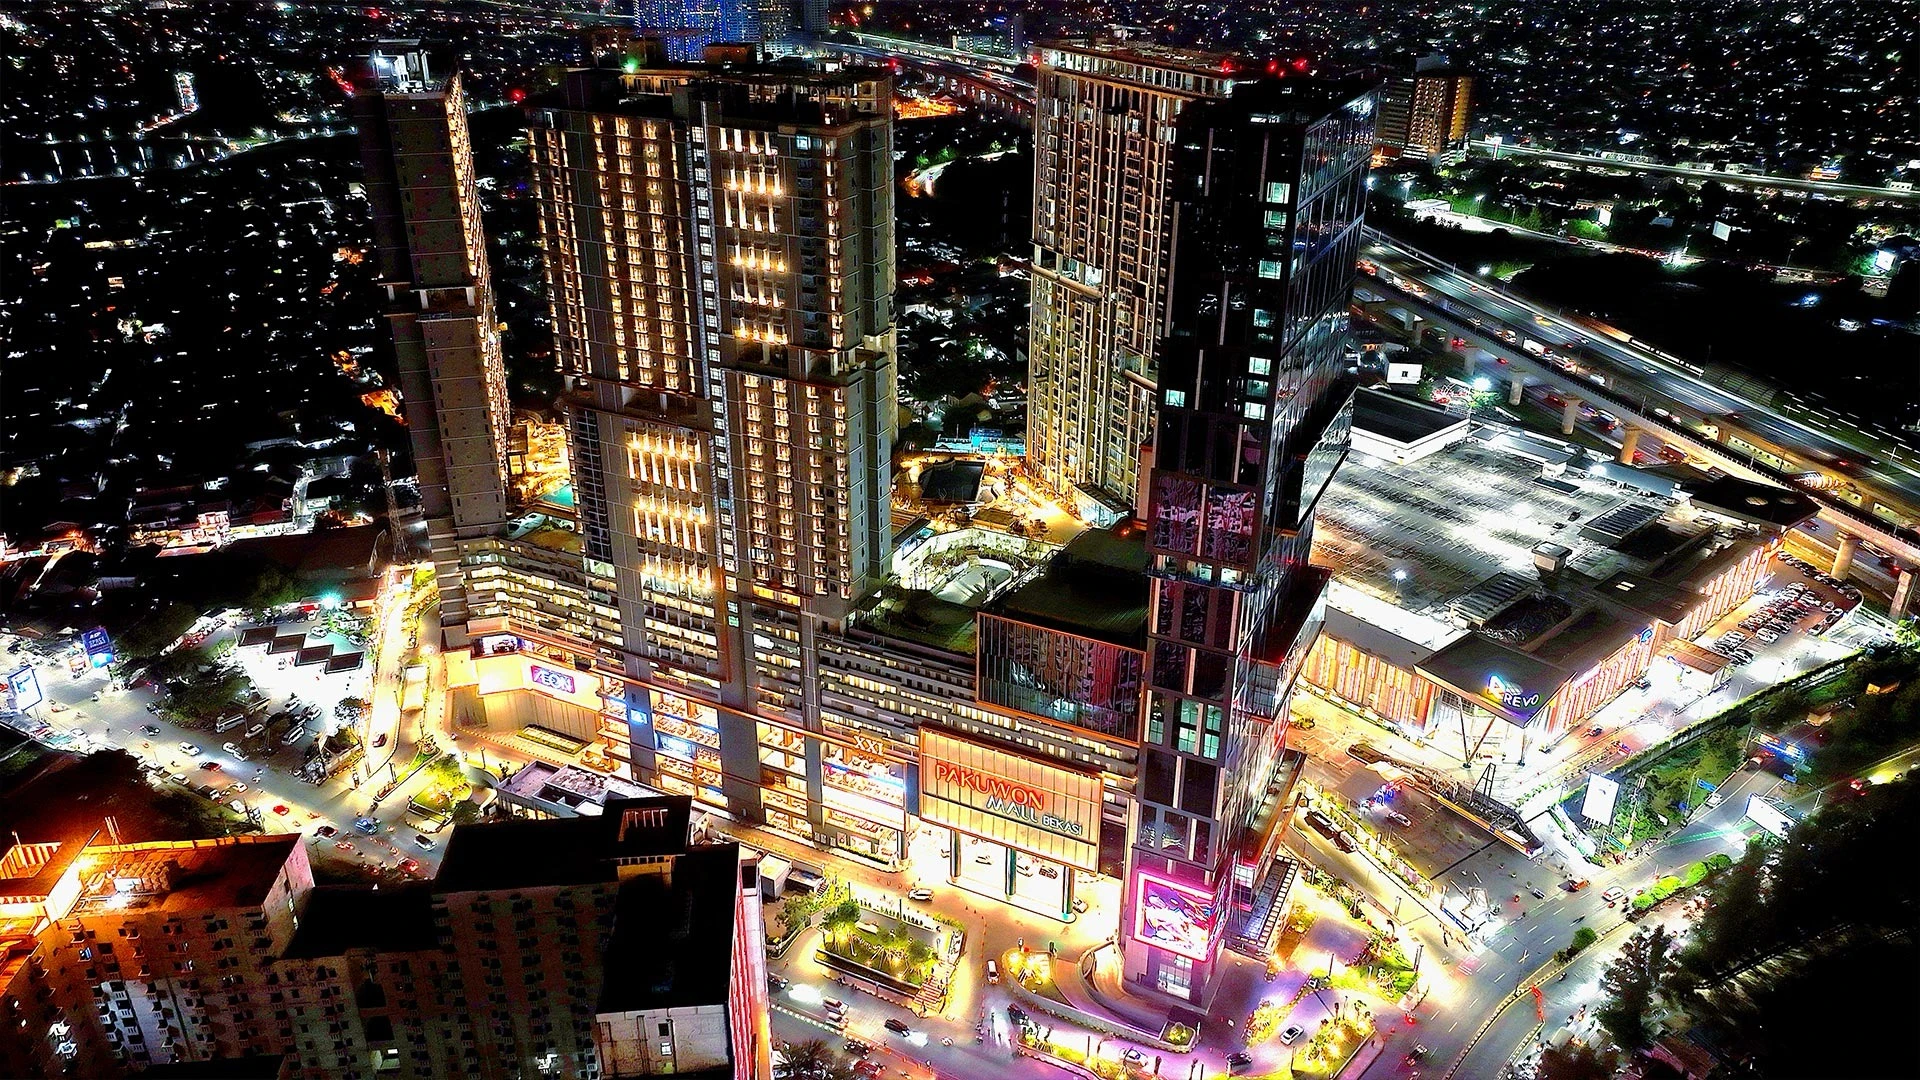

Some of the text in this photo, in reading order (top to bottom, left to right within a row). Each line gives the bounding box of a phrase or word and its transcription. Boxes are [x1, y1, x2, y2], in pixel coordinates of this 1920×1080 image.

[1503, 692, 1539, 707] REVO
[853, 735, 883, 756] XXI
[934, 762, 1044, 810] PAKUWON
[986, 795, 1083, 835] MALL BEKASI
